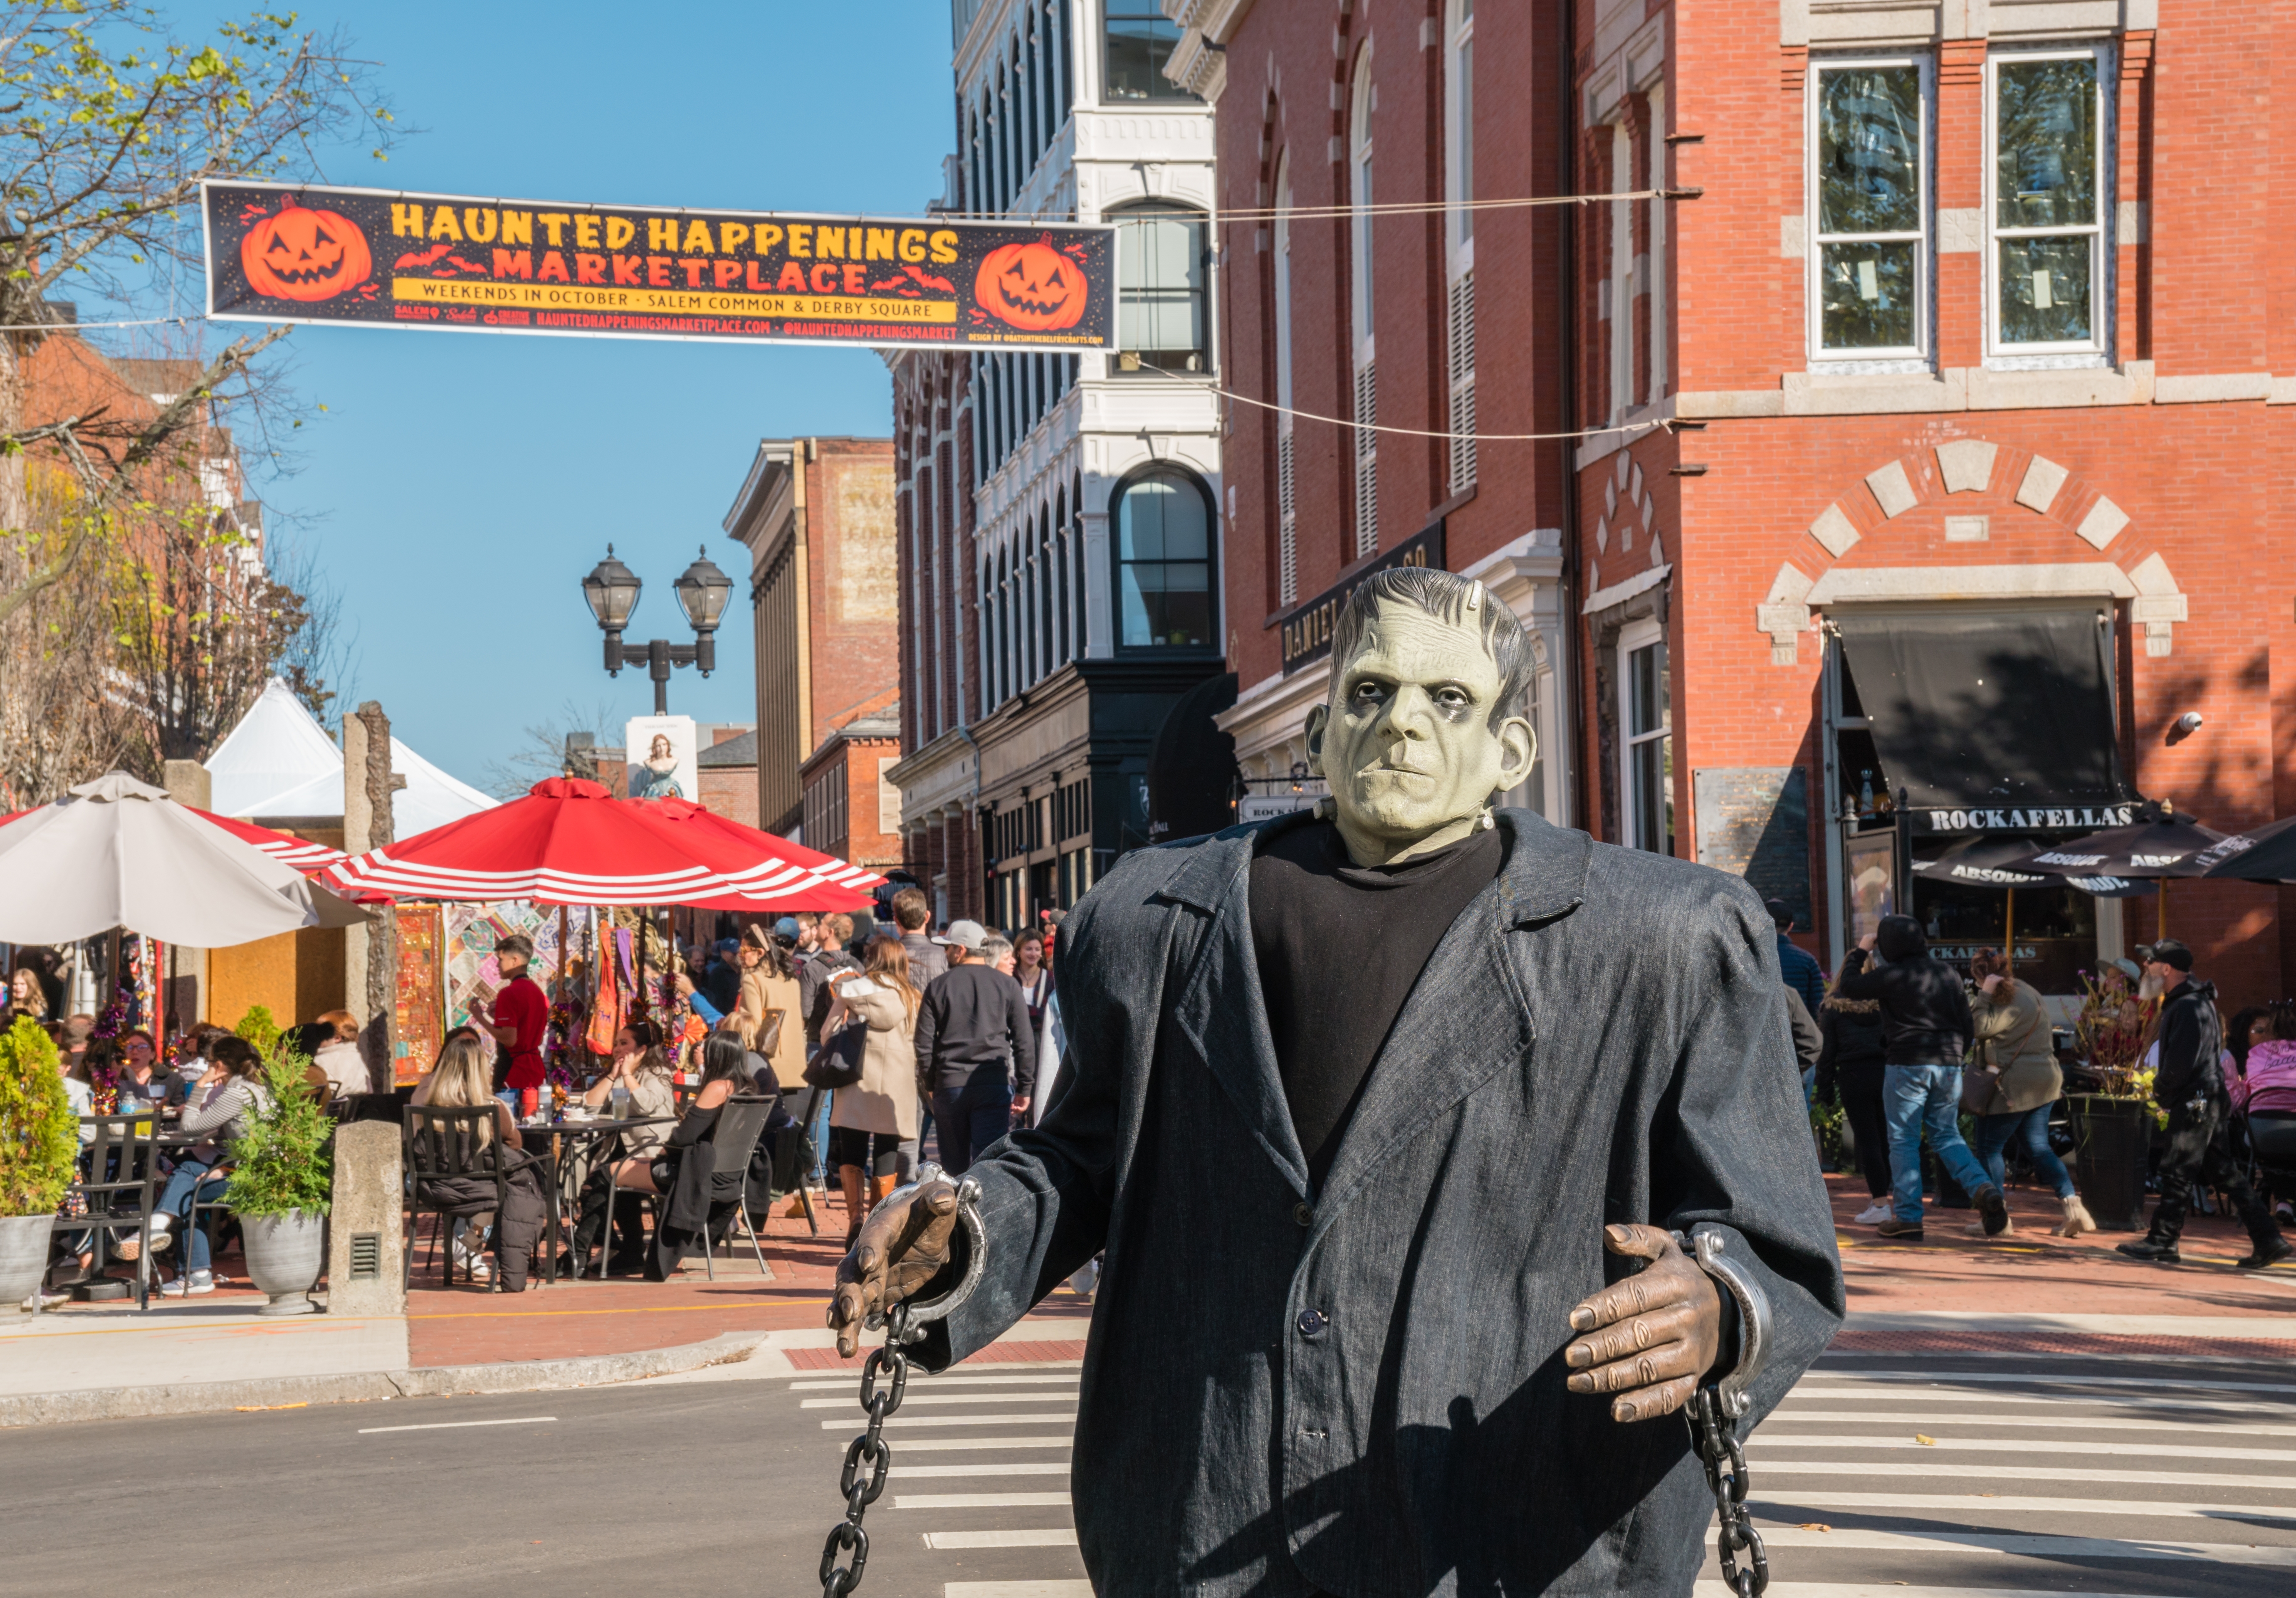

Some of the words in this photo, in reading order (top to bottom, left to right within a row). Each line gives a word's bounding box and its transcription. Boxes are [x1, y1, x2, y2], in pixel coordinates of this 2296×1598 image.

[391, 204, 634, 249] HAUNTED
[648, 219, 958, 264] HAPPENINGS
[492, 248, 867, 294] MARKETPLACE
[395, 305, 429, 314] SALEM
[423, 283, 517, 301] WEEKENDS
[525, 289, 541, 301] IN
[549, 290, 628, 305] OCTOBER
[648, 294, 701, 308] SALEM
[709, 297, 784, 311] COMMON
[794, 300, 804, 312] &
[813, 301, 862, 314] DERBY
[870, 303, 932, 317] SQUARE
[536, 312, 771, 334] HAUNTEDHAPPENINGSMARKETPLACE.COM
[783, 322, 957, 340] @HAUNTEDHAPPENINGSMARKET
[1285, 598, 1337, 662] DANIEL
[1930, 807, 2133, 830] ROCKAFELLAS
